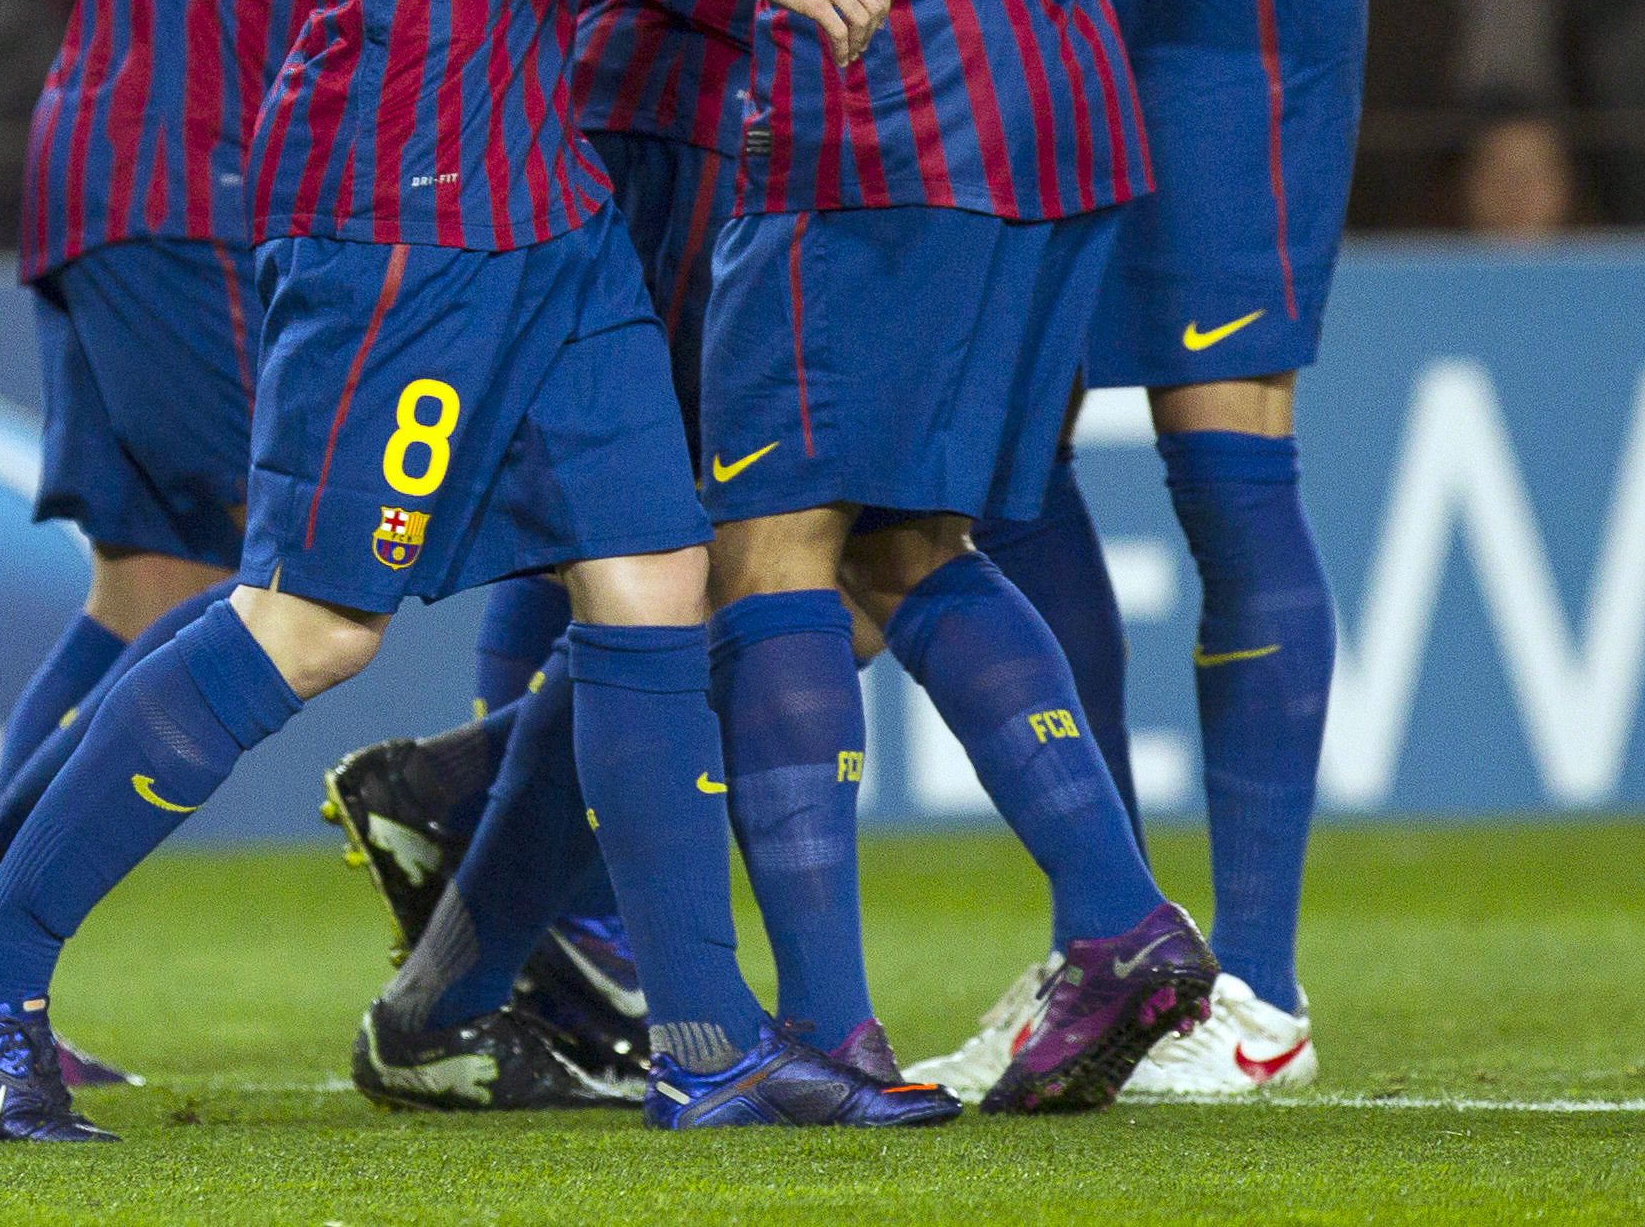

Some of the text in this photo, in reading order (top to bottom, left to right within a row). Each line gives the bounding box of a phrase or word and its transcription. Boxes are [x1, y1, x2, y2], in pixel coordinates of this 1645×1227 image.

[411, 173, 458, 187] DRI-FIT
[383, 379, 461, 497] 8
[1028, 709, 1080, 744] FCB
